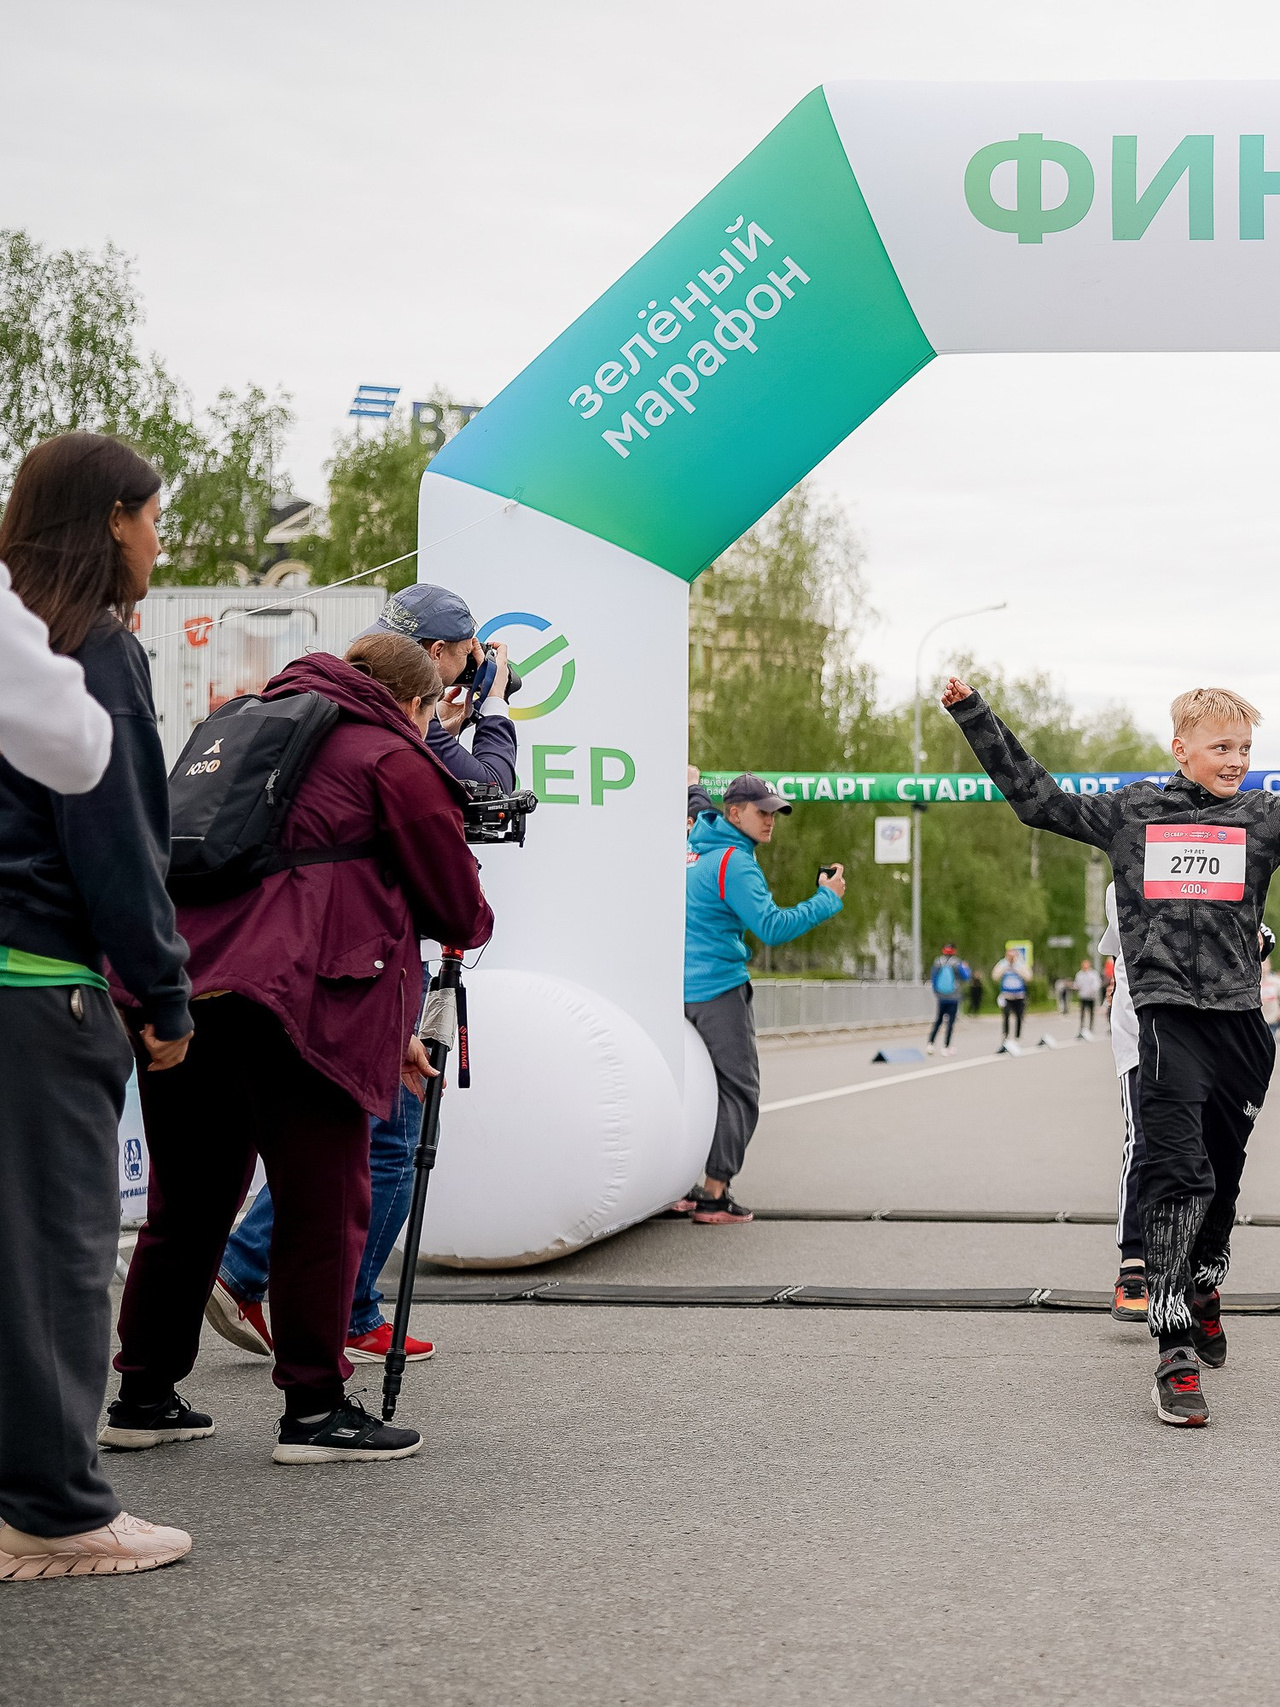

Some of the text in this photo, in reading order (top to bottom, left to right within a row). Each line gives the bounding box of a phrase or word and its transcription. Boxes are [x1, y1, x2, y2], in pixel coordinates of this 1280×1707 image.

[568, 214, 775, 420] зелёный
[600, 255, 812, 460] марафон
[515, 744, 636, 807] ЕР
[776, 777, 876, 801] СТАРТ
[896, 777, 995, 801] СТАРТ
[1055, 776, 1120, 795] АРТ
[1170, 856, 1220, 875] 2770
